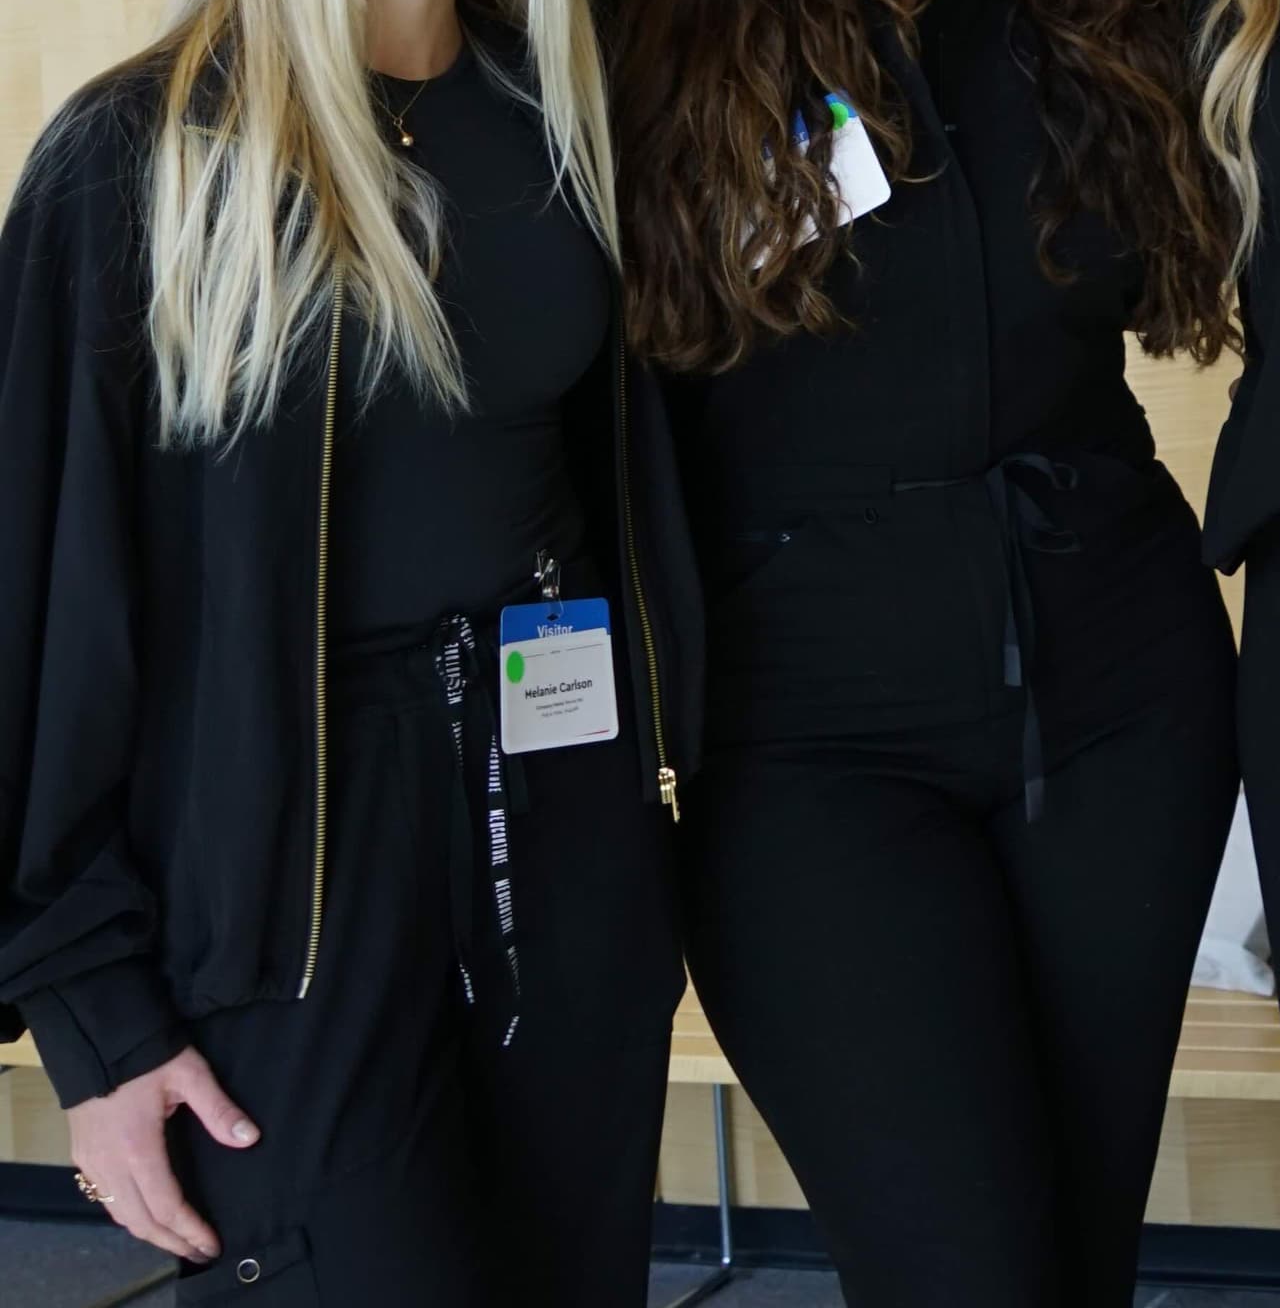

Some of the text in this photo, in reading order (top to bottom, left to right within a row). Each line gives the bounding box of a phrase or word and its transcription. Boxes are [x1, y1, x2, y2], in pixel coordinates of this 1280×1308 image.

[536, 624, 574, 638] Visitor
[525, 677, 593, 700] Melanie Carlson
